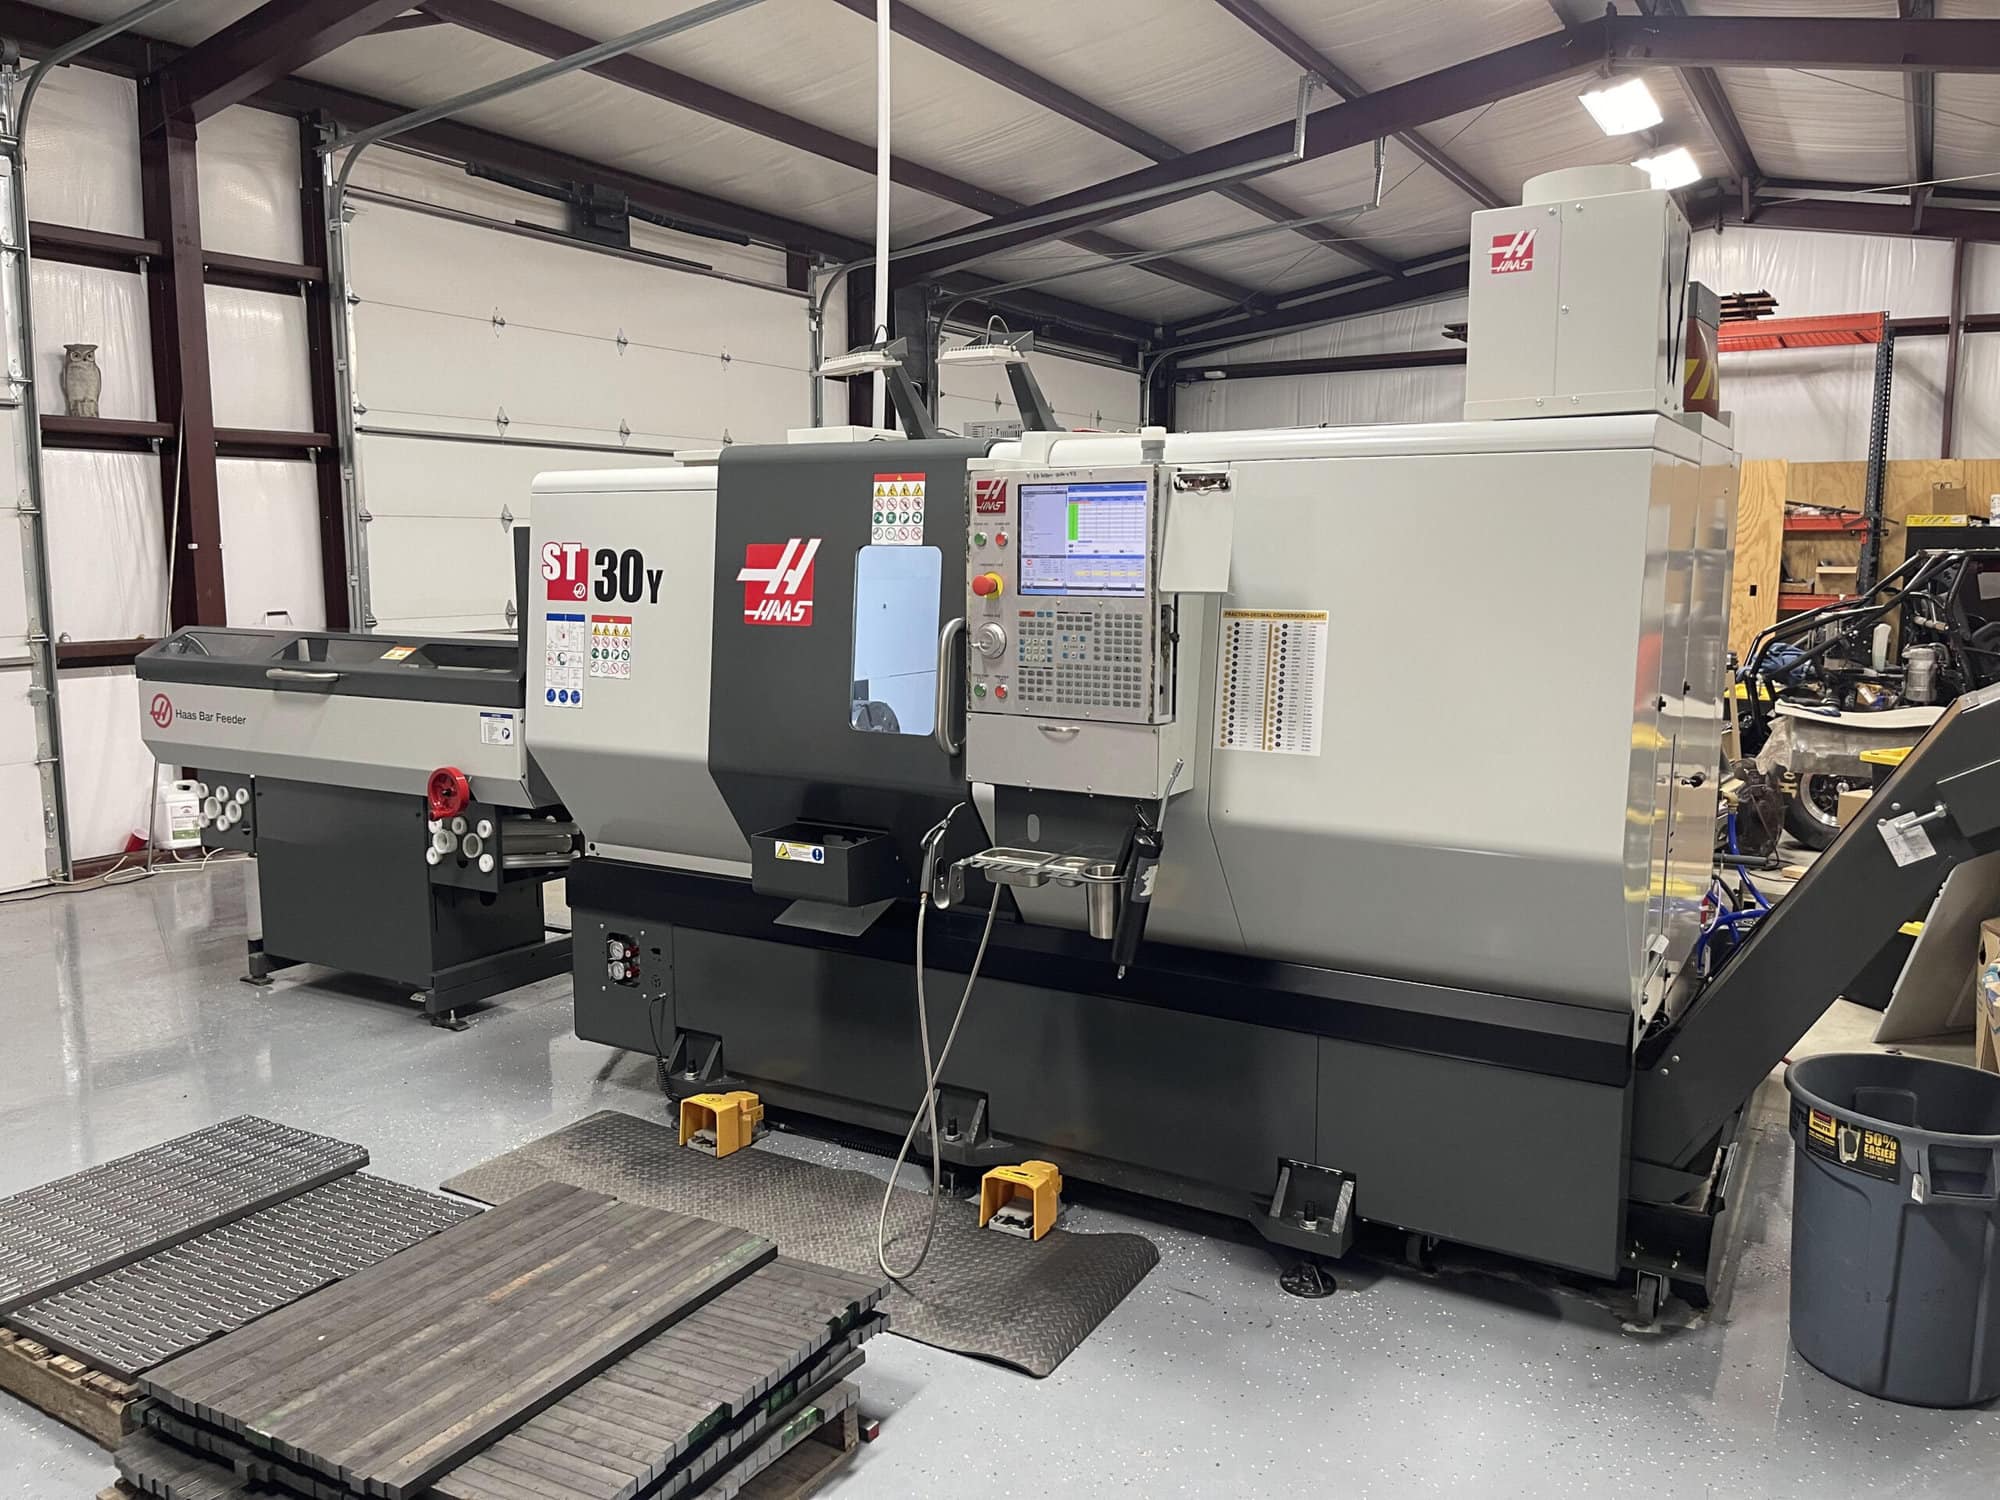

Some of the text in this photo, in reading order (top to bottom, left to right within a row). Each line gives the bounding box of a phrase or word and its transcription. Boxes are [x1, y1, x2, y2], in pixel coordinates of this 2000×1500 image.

[1491, 258, 1533, 272] HAAS
[542, 541, 582, 581] ST
[744, 599, 814, 622] HAAS
[175, 709, 247, 725] Haas Bar Feeder
[1864, 1130, 1897, 1150] 50%
[1863, 1143, 1896, 1160] EASIER
